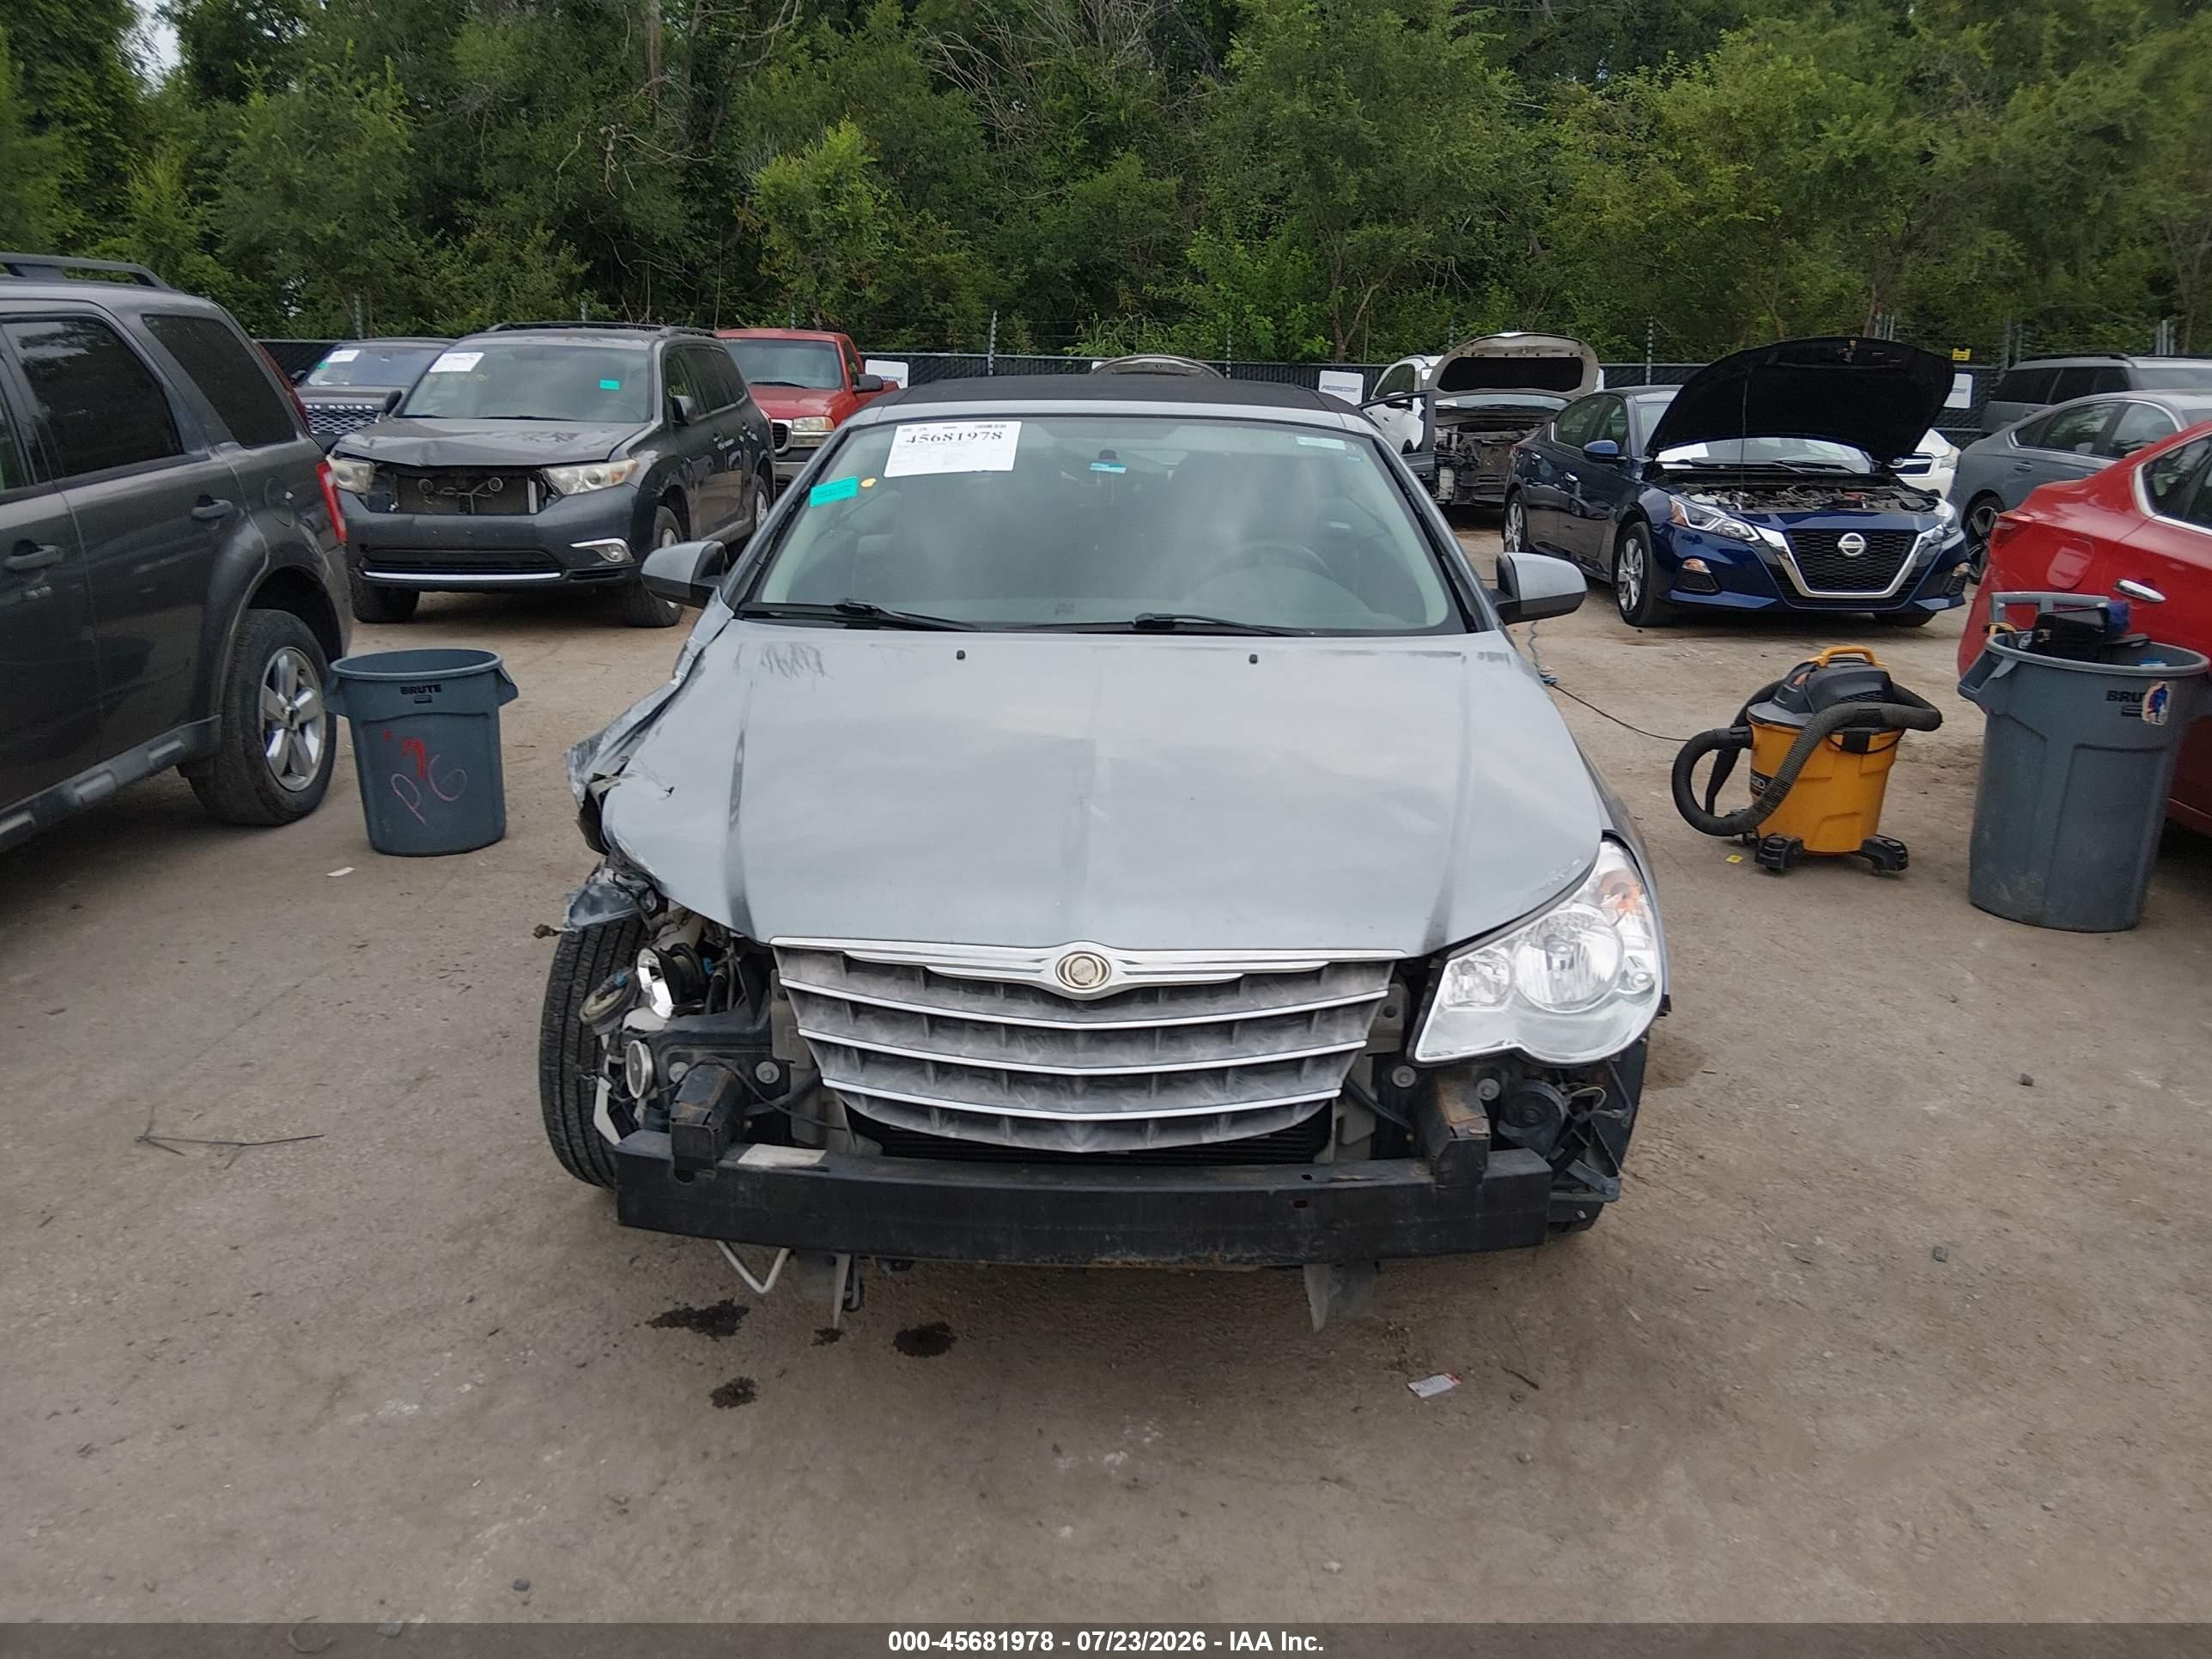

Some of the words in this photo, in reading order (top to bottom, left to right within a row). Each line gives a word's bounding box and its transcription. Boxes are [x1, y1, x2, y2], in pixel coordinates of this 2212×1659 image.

[906, 431, 1003, 443] 45681978
[400, 684, 442, 694] BRUTE
[2106, 690, 2147, 702] BRU
